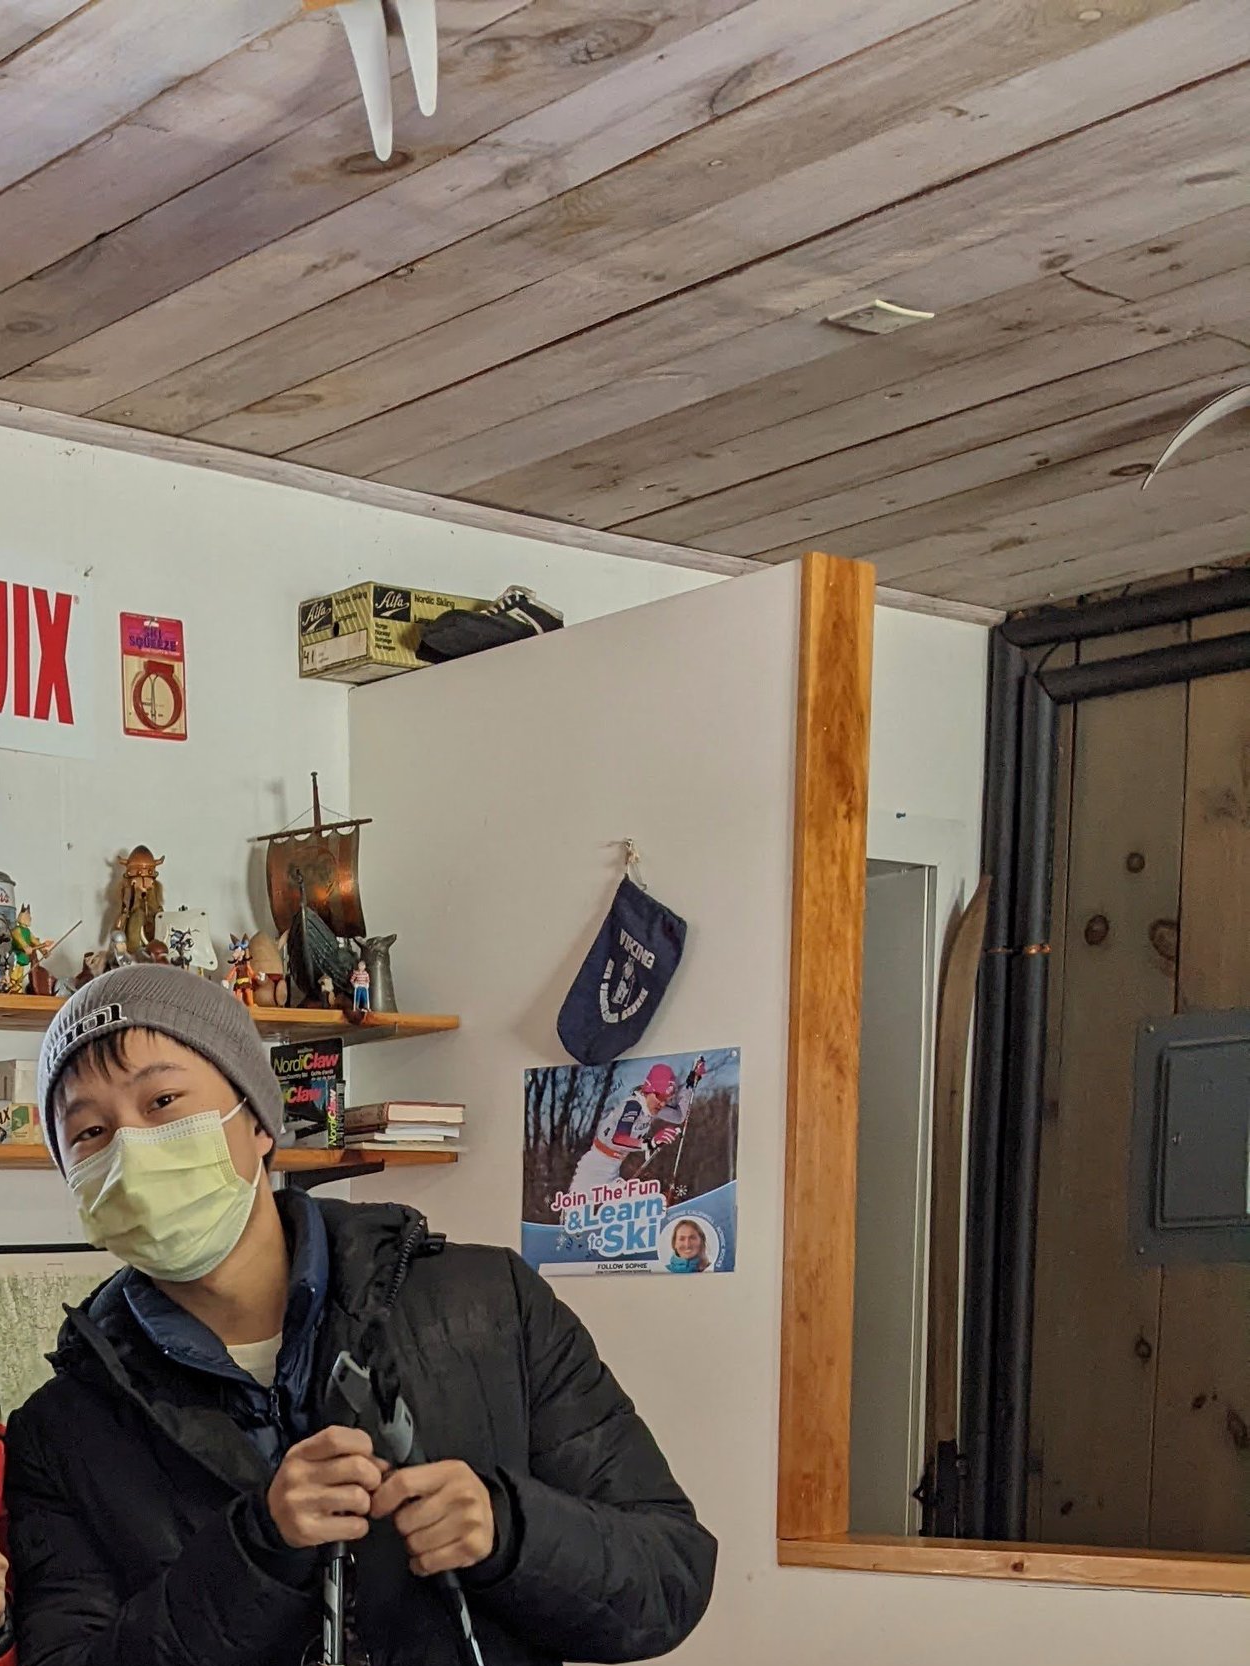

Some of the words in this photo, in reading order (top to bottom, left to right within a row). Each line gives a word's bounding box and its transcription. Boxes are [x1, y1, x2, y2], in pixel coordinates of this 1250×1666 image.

[375, 590, 410, 609] Alfa
[414, 594, 434, 604] Nordic
[436, 596, 455, 609] Skiing
[302, 602, 332, 626] Alfa
[129, 634, 177, 652] SQUEEZE
[620, 928, 656, 970] VIKING
[274, 1053, 340, 1074] NordiClaw
[552, 1193, 587, 1210] Join
[592, 1185, 623, 1203] The
[629, 1181, 659, 1197] Fun
[589, 1235, 604, 1249] to
[603, 1218, 658, 1253] Ski
